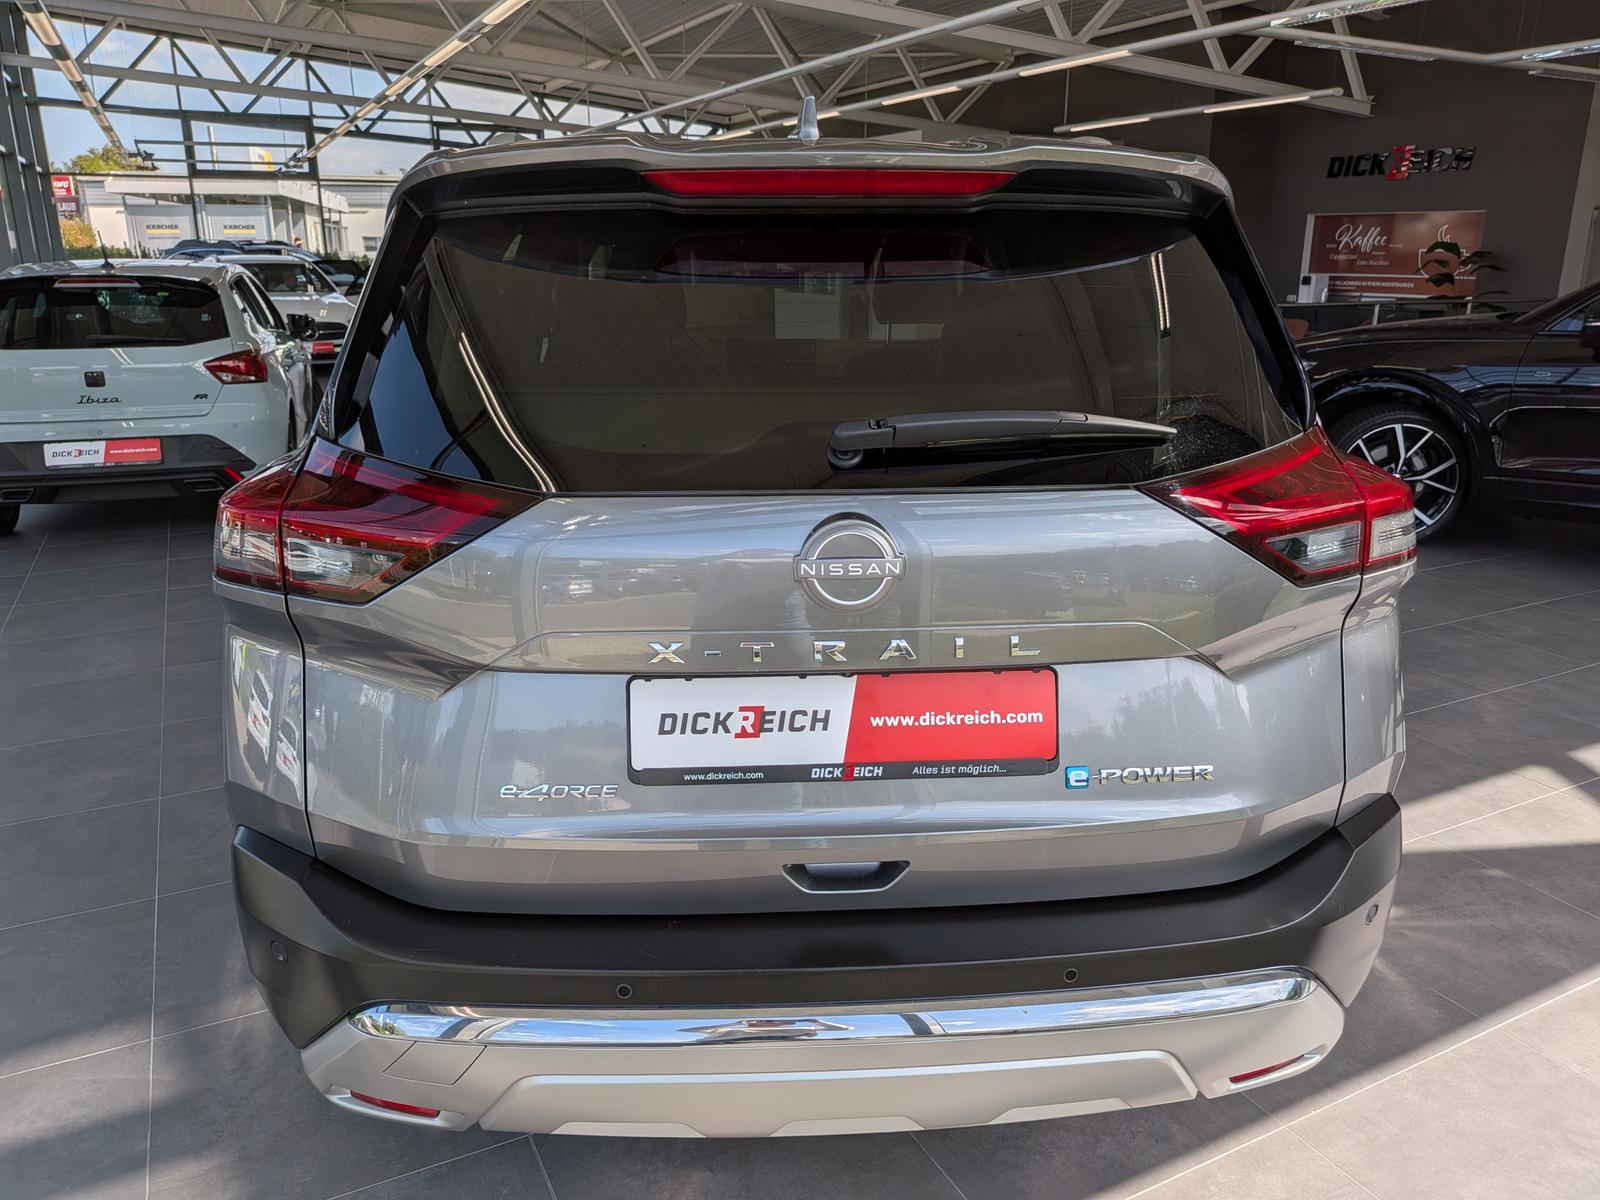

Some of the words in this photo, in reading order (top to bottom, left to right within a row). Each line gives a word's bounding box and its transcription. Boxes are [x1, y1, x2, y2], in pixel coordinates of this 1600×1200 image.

[1335, 223, 1388, 253] Kaffee
[76, 395, 122, 404] Ibiza
[52, 448, 100, 458] DICKREICH
[800, 562, 900, 576] NISSAN
[648, 635, 1041, 664] X-TRAIL
[657, 705, 831, 739] DICKREICH
[869, 710, 1044, 728] www.dickreich.com
[683, 770, 765, 783] www.dickreich.com
[811, 764, 883, 780] DICKREICH
[912, 765, 939, 776] Alles
[940, 765, 956, 775] ist
[958, 763, 1007, 776] möglich...
[1066, 765, 1214, 788] e-POWER
